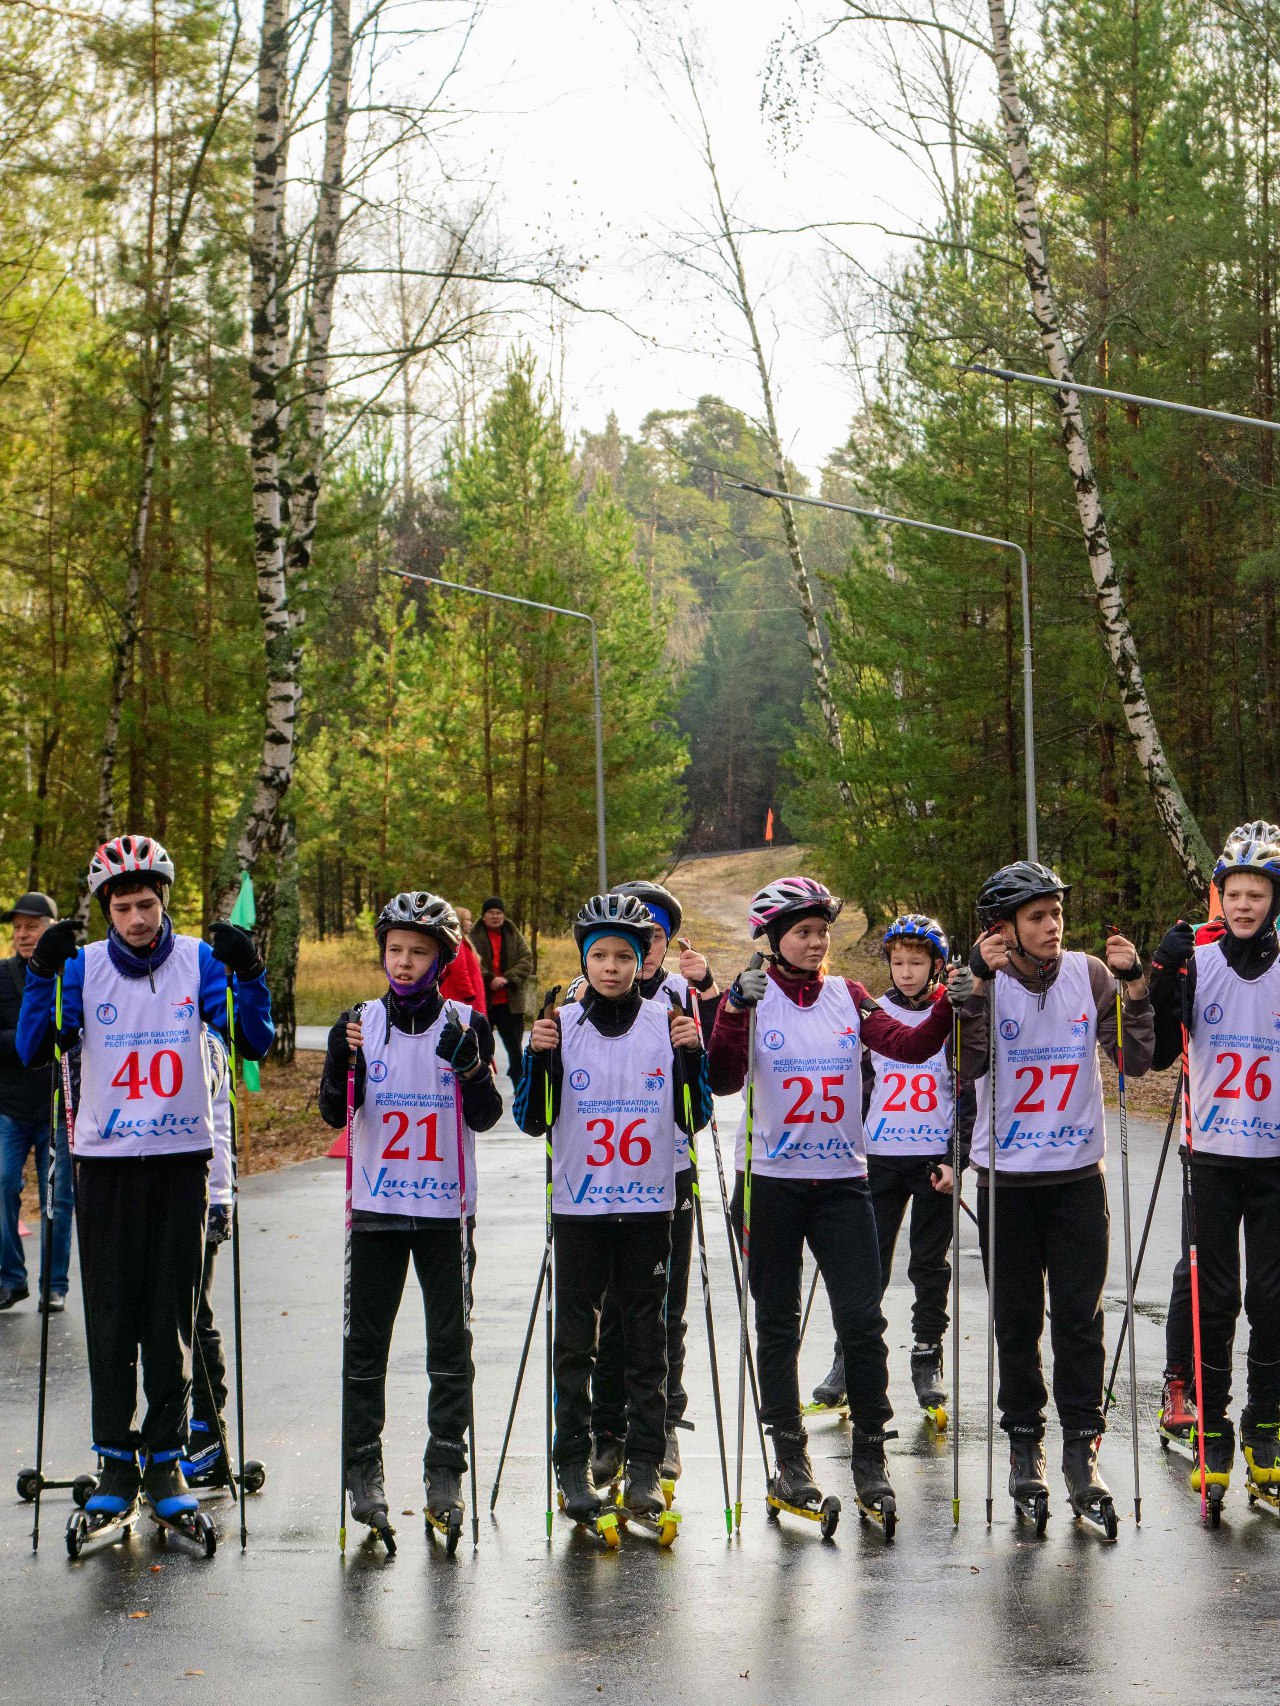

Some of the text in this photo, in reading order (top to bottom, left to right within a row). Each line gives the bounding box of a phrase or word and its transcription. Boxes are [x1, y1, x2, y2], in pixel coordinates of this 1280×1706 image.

[105, 1029, 190, 1041] ФЕДЕРАЦИЯ БИАТЛОНА
[104, 1039, 152, 1048] РЕСПУБЛИКИ
[1209, 1041, 1251, 1049] РЕСПУБЛИКИ
[1008, 1045, 1086, 1056] ФЕДЕРАЦИЯ БИАТЛОНА
[773, 1057, 853, 1066] ФЕДЕРАЦИЯ БИАТЛОНА
[1007, 1054, 1053, 1062] РЕСПУБЛИКИ
[773, 1065, 821, 1073] РЕСПУБЛИКИ
[111, 1050, 184, 1100] 40
[1213, 1052, 1272, 1102] 26
[882, 1073, 938, 1113] 28
[1013, 1064, 1080, 1113] 27
[417, 1093, 454, 1102] БИАТЛОНА
[782, 1074, 845, 1125] 25
[375, 1099, 418, 1107] РЕСПУБЛИКИ
[381, 1111, 444, 1161] 21
[586, 1118, 652, 1167] 36
[780, 1431, 801, 1441] TISA
[1079, 1428, 1098, 1437] TISA
